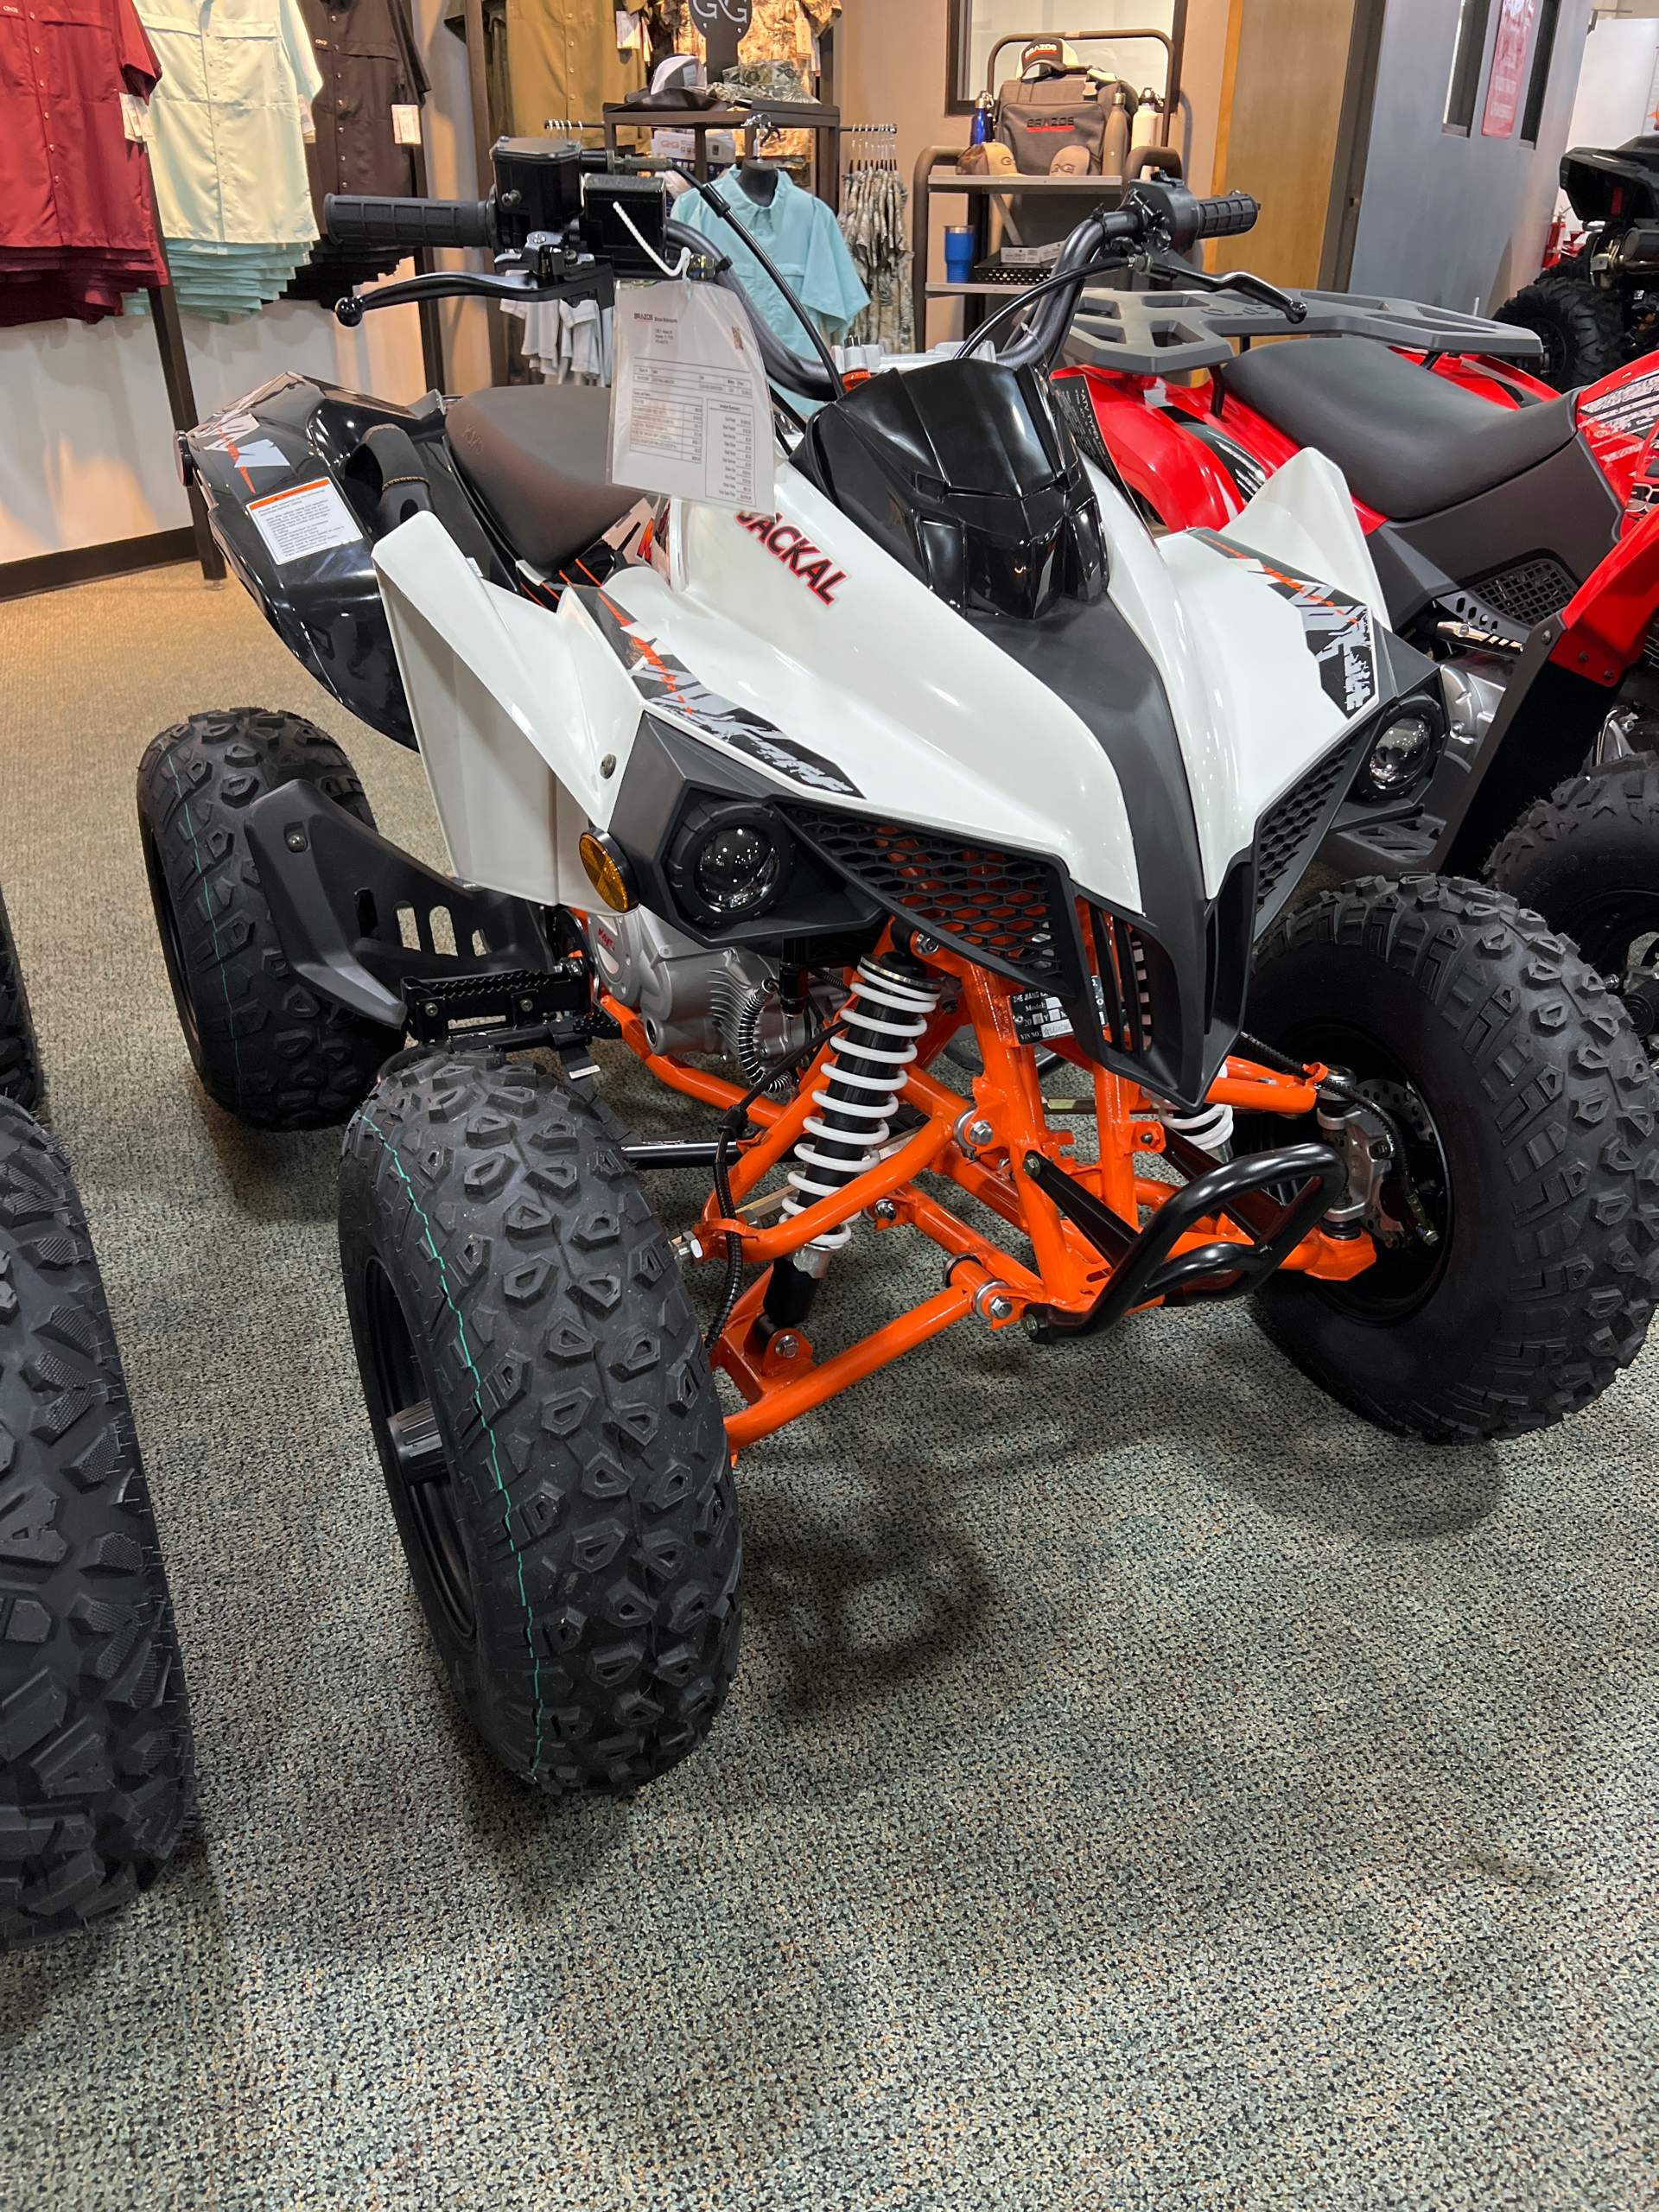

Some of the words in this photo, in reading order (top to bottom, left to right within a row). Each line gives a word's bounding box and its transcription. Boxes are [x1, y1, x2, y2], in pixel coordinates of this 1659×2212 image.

[1025, 43, 1058, 59] BRAZOS
[1027, 117, 1074, 128] BRAZOS
[1013, 995, 1024, 1003] ZHE
[1024, 991, 1039, 1001] JIANG
[1025, 1001, 1046, 1012] Model:
